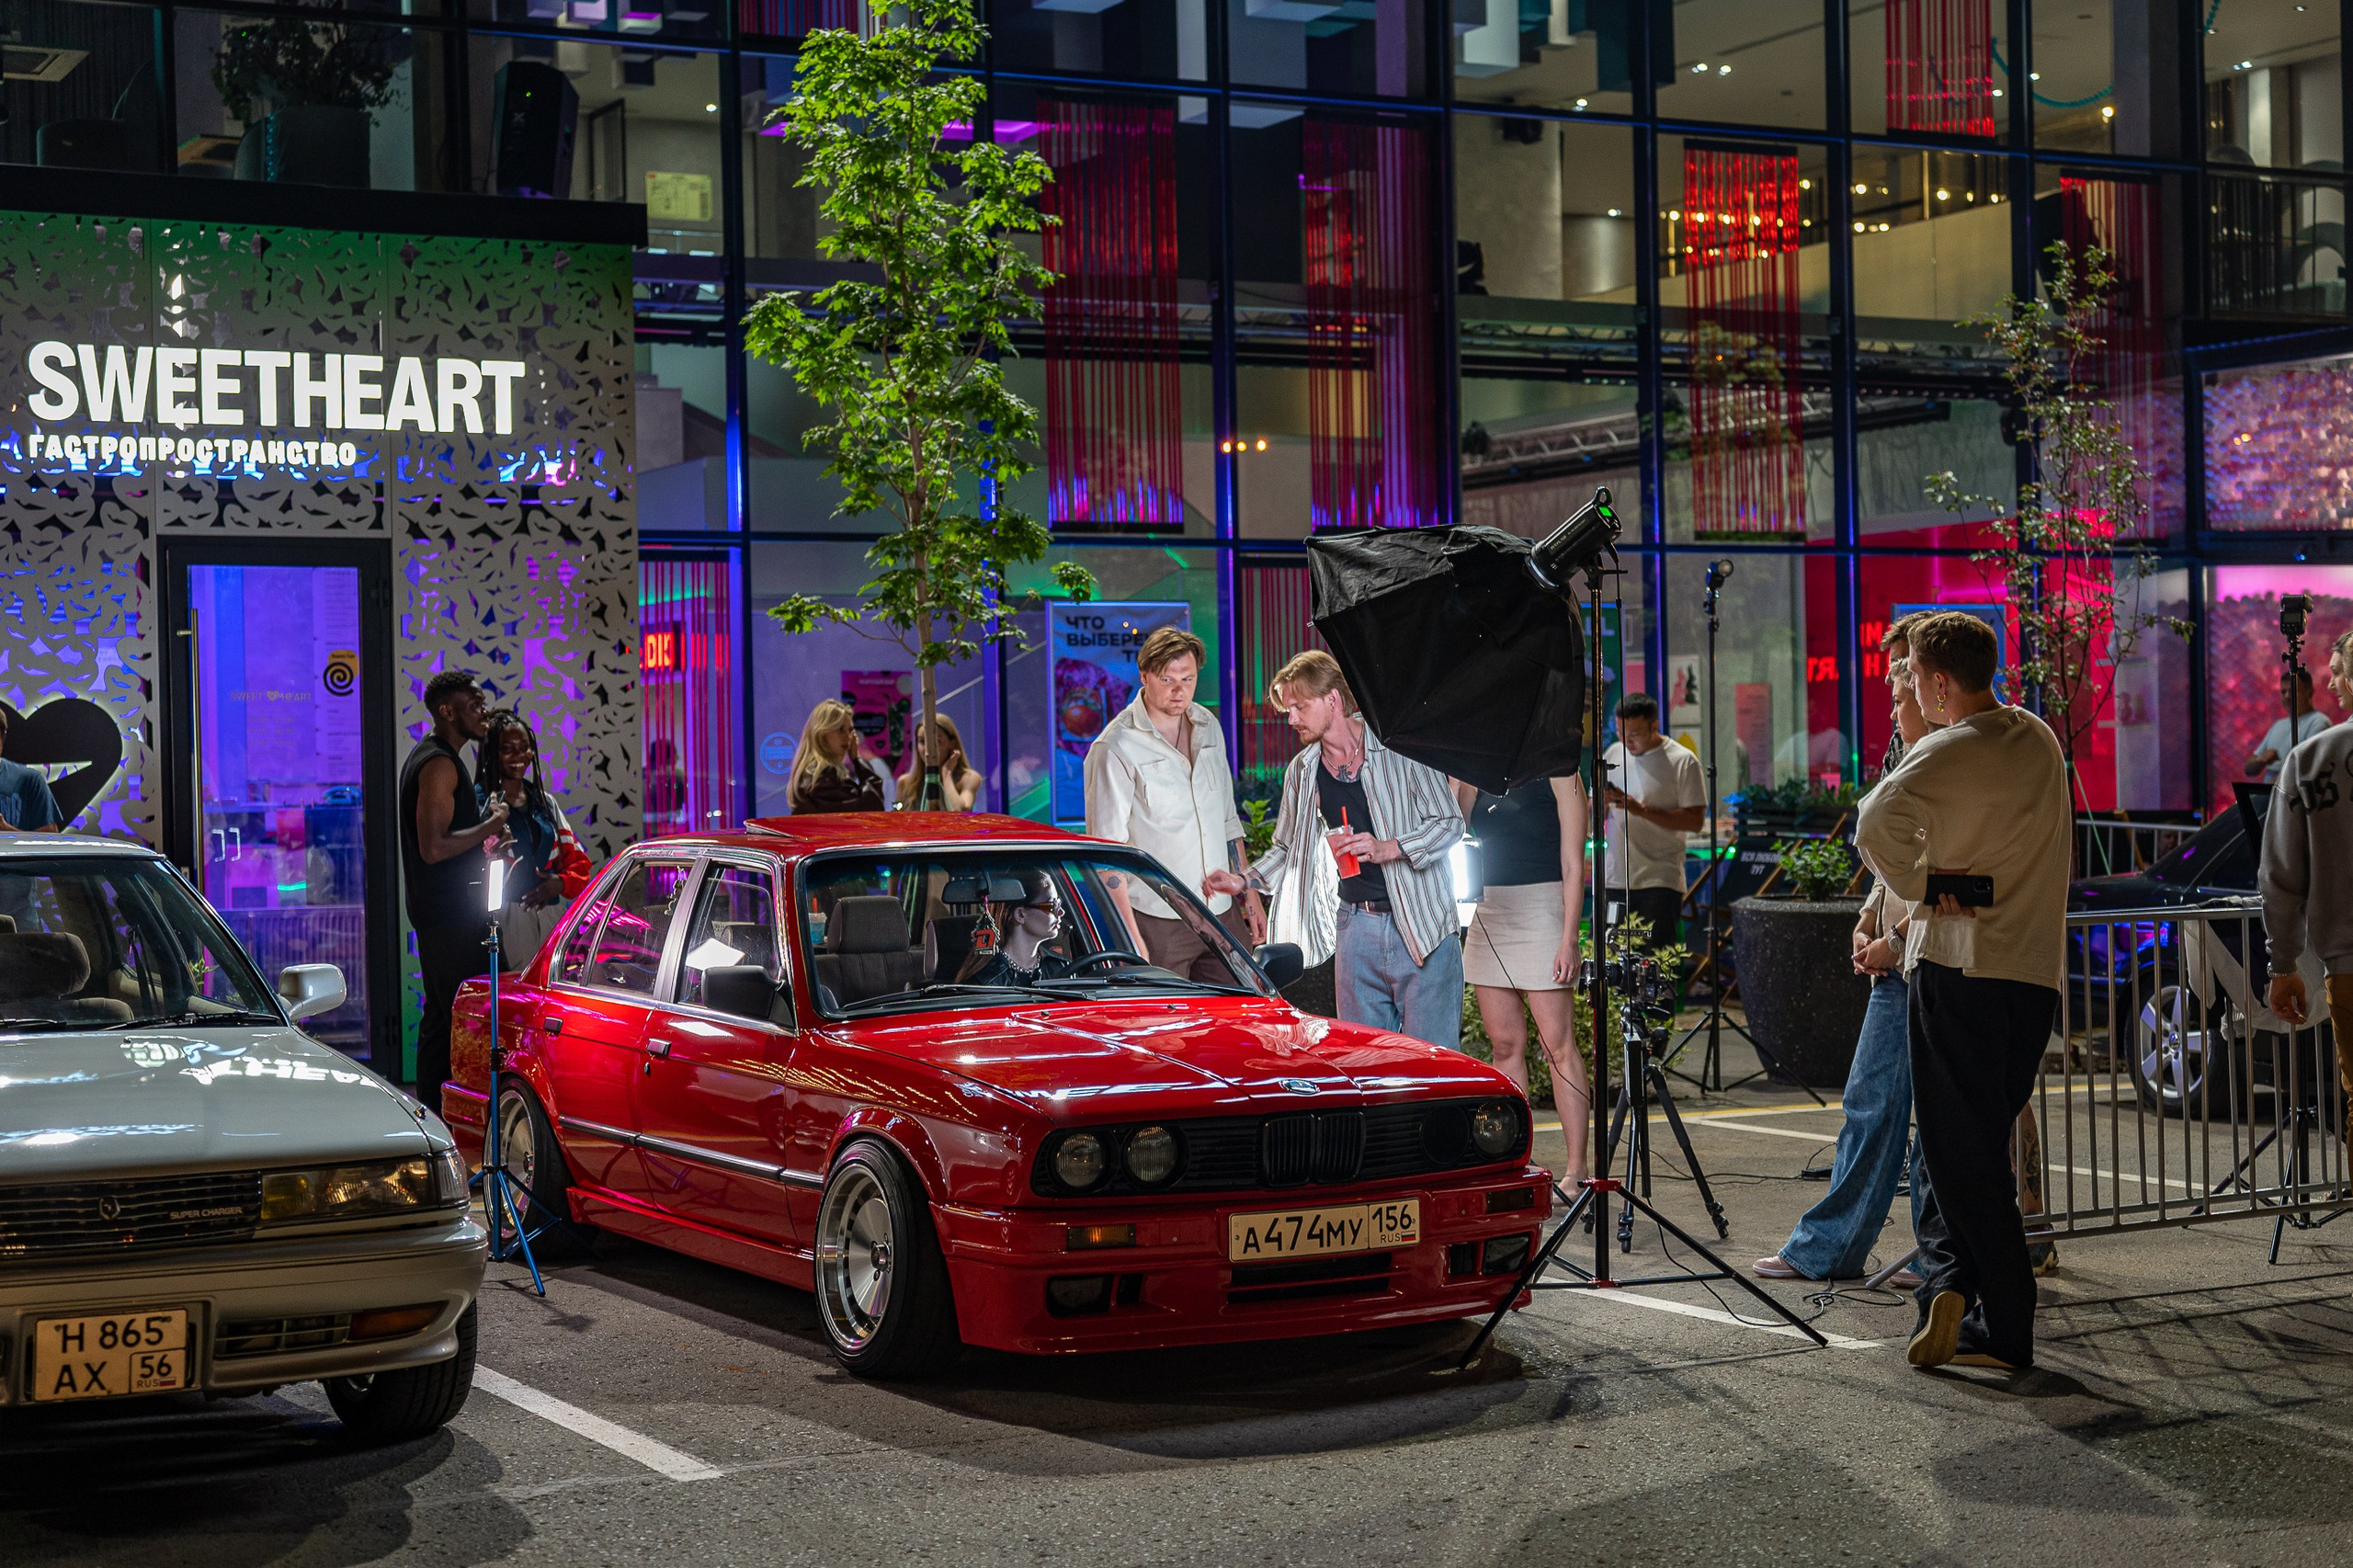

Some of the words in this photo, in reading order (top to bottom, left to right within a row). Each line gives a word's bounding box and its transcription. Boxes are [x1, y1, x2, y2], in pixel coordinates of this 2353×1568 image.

[28, 340, 526, 436] SWEETHEART
[28, 434, 358, 466] ГАСТРОПРОСТРАНСТВО
[1065, 615, 1105, 631] ЧТО
[1066, 632, 1149, 647] ВЫБЕРЕ
[231, 690, 263, 701] SWEET
[281, 691, 312, 701] HEART
[1750, 864, 1765, 875] ТУТ
[170, 1210, 200, 1220] SUPER
[201, 1206, 244, 1217] CHARGER
[1242, 1214, 1364, 1255] А474МУ
[1372, 1204, 1412, 1233] 156
[1380, 1233, 1401, 1244] RUS
[98, 1316, 165, 1350] 865
[140, 1354, 172, 1380] 56
[53, 1361, 108, 1395] АХ
[137, 1380, 159, 1389] RUS
